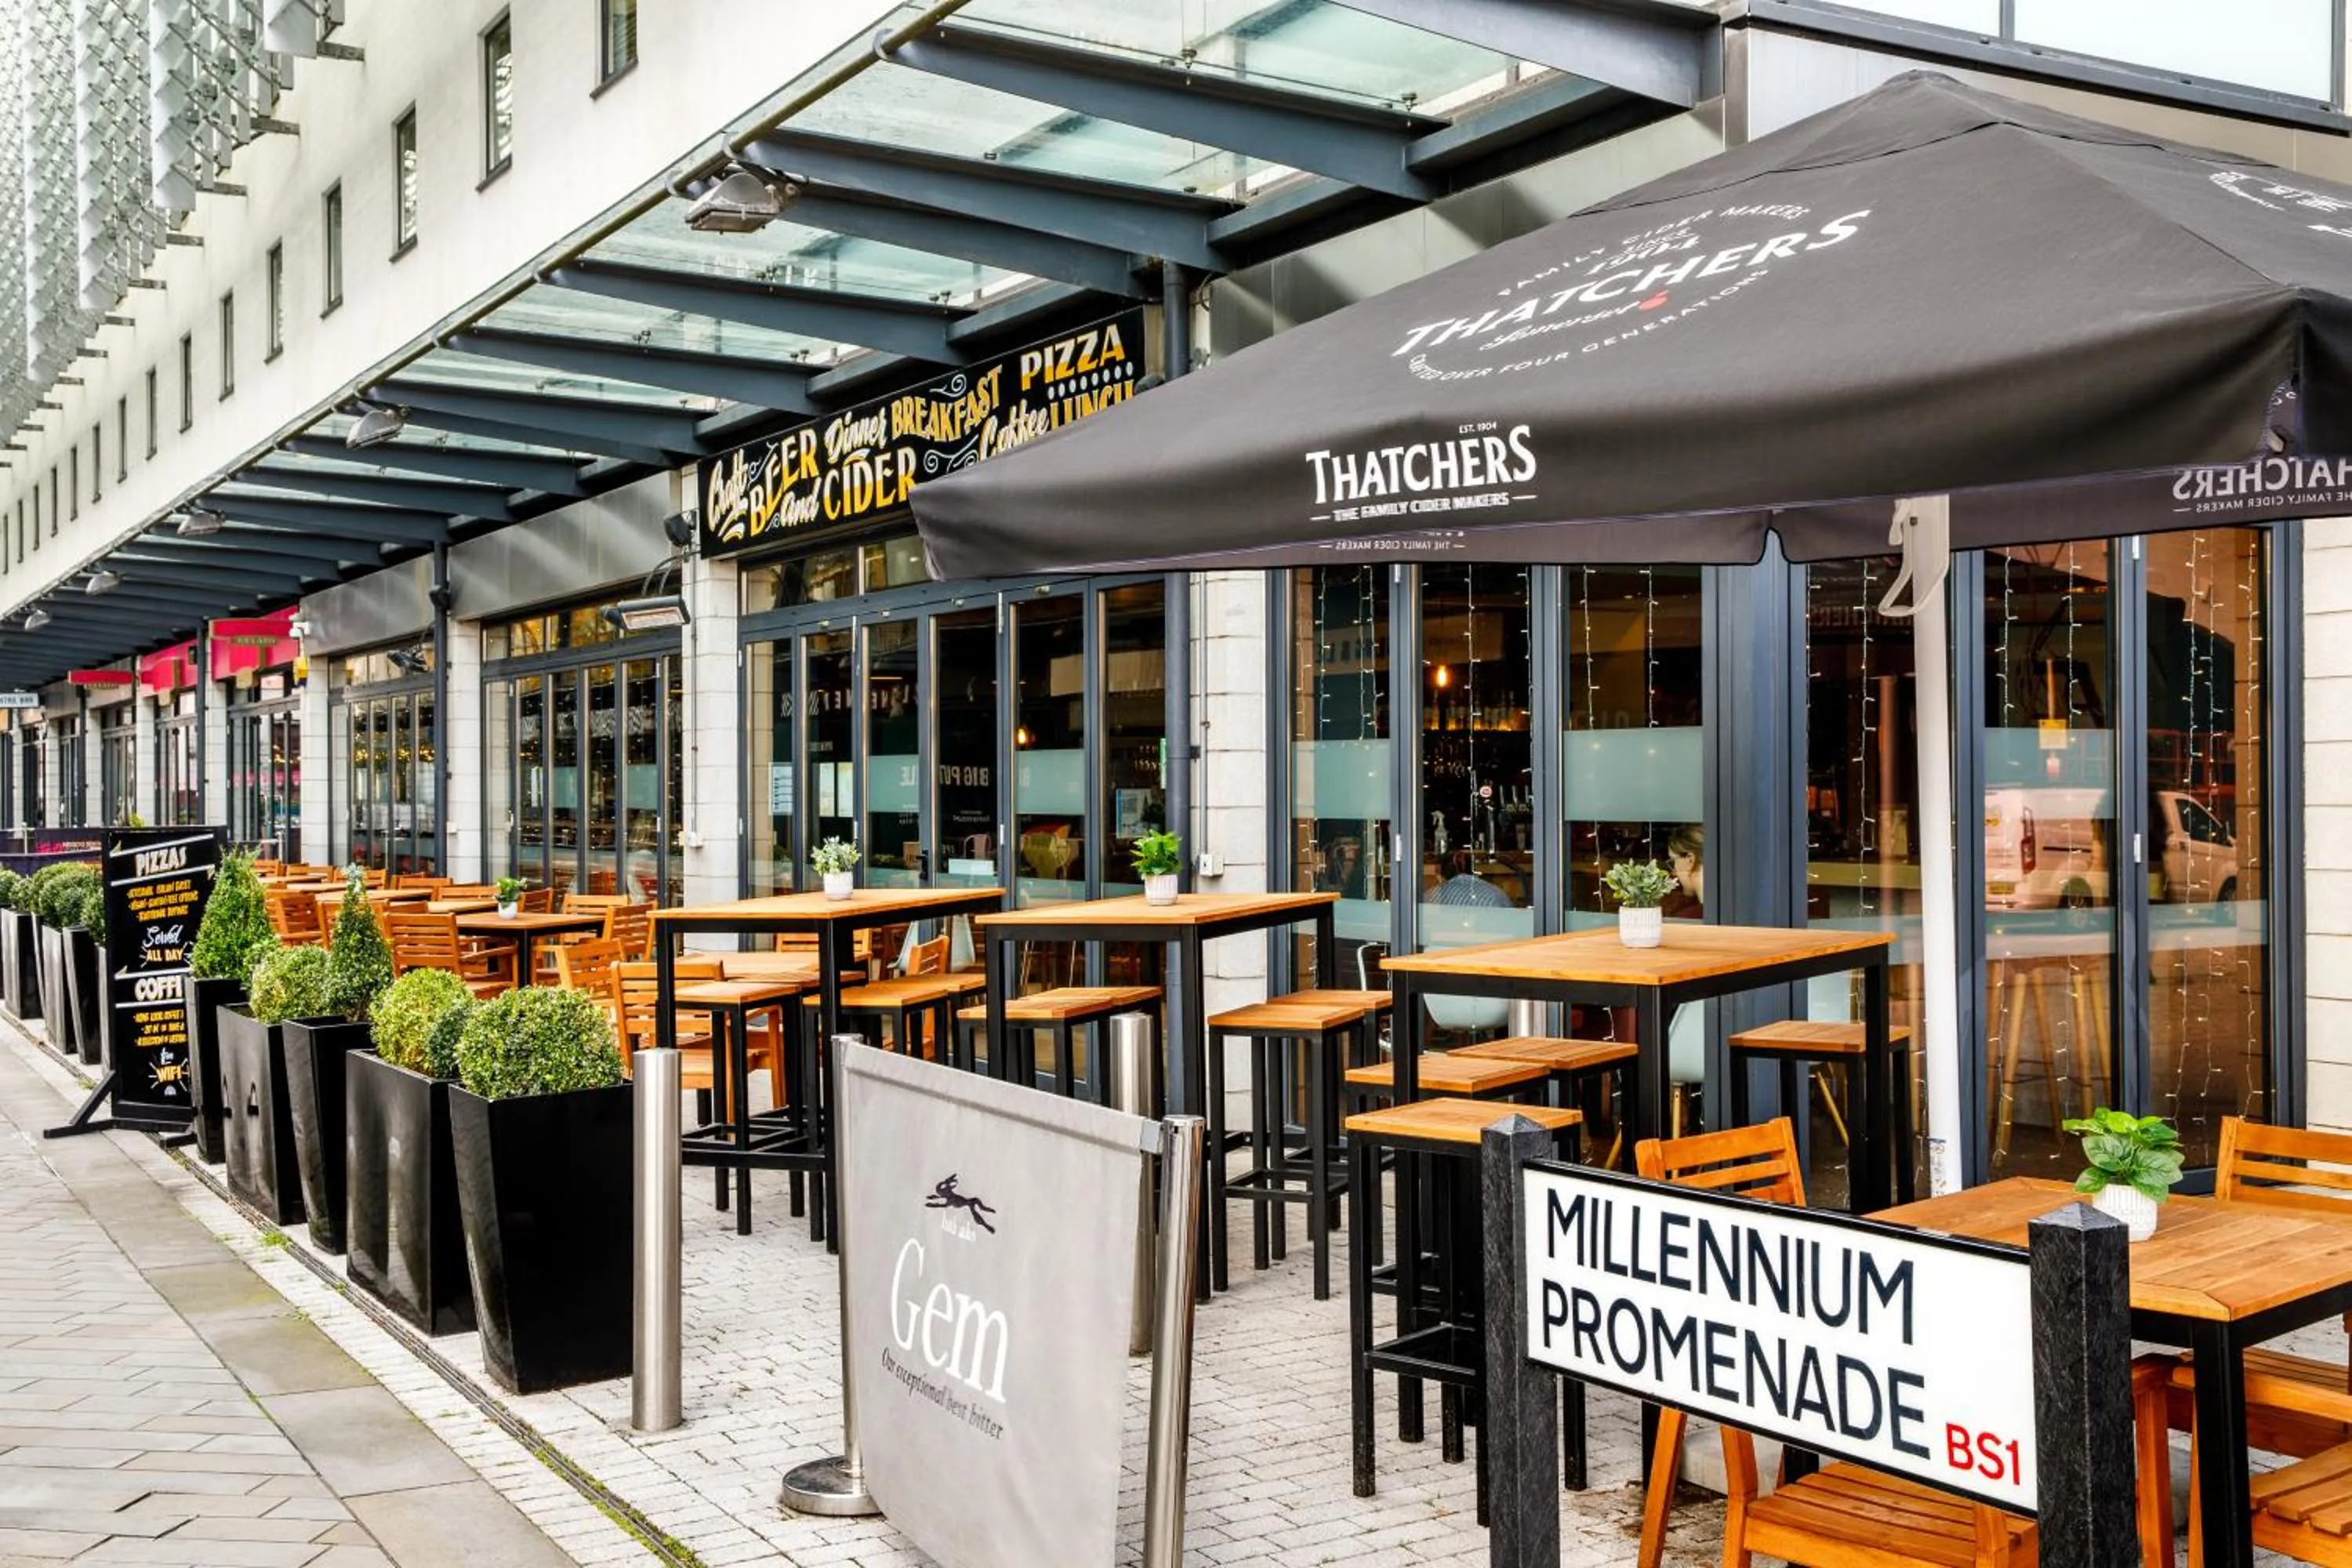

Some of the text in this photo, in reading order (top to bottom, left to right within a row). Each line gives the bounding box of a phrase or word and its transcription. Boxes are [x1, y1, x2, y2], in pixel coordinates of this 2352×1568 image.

[1392, 209, 1872, 357] THATCHERS
[1020, 323, 1127, 391] PIZZA
[824, 410, 889, 466] Dinner
[891, 364, 1003, 442] BREAKFAST
[1459, 421, 1497, 434] EST. 1904
[750, 428, 820, 537] BEER
[824, 445, 916, 521] CIDER
[1305, 425, 1537, 504] THATCHERS
[1333, 492, 1510, 521] THE FAMILY CIDER MAKERS
[135, 846, 187, 878] PIZZAS
[134, 975, 182, 1001] COFF
[147, 948, 184, 961] ALL DAY
[1546, 1187, 1914, 1345] MILLENNIUM
[891, 1237, 1009, 1404] Gem
[1542, 1277, 2021, 1486] PROMENADE BS1
